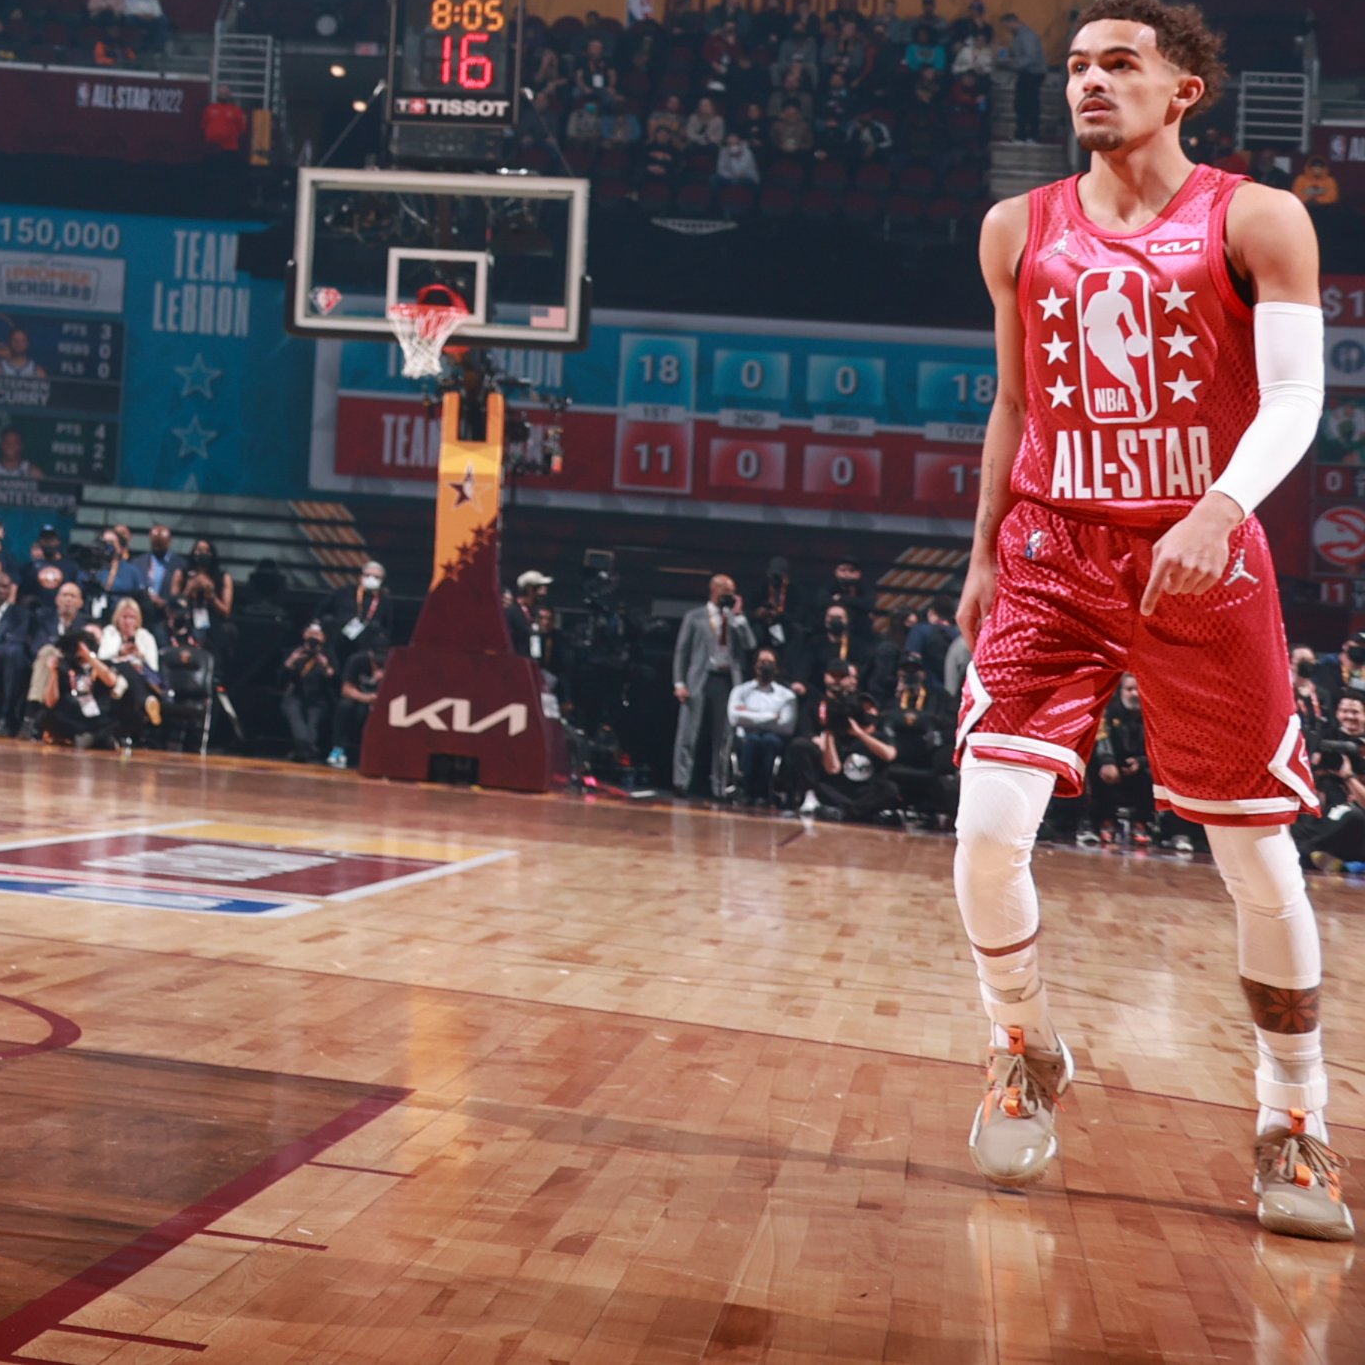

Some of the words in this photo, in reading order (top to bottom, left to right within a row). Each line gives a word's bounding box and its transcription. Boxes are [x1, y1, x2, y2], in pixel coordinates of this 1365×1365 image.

[440, 32, 494, 90] 16
[91, 84, 151, 112] ALL-STAR
[151, 88, 184, 114] 2022
[428, 100, 510, 117] TISSOT
[174, 230, 239, 283] TEAM
[152, 280, 251, 338] LeBRON
[100, 323, 112, 340] 3
[98, 344, 111, 360] 0
[97, 363, 110, 378] 0
[639, 354, 680, 385] 18
[740, 359, 763, 390] 0
[835, 365, 858, 395] 0
[950, 373, 995, 404] 18
[1094, 387, 1129, 413] NBA
[94, 424, 106, 439] 4
[642, 407, 668, 420] 1ST
[733, 412, 765, 426] 2ND
[829, 419, 859, 433] 3RD
[946, 425, 984, 439] TOTA
[92, 443, 105, 460] 2
[633, 442, 673, 474] 11
[736, 449, 760, 480] 0
[830, 455, 855, 486] 0
[1051, 425, 1213, 500] ALL-STAR
[1324, 471, 1342, 492] 0
[1320, 582, 1345, 604] 11
